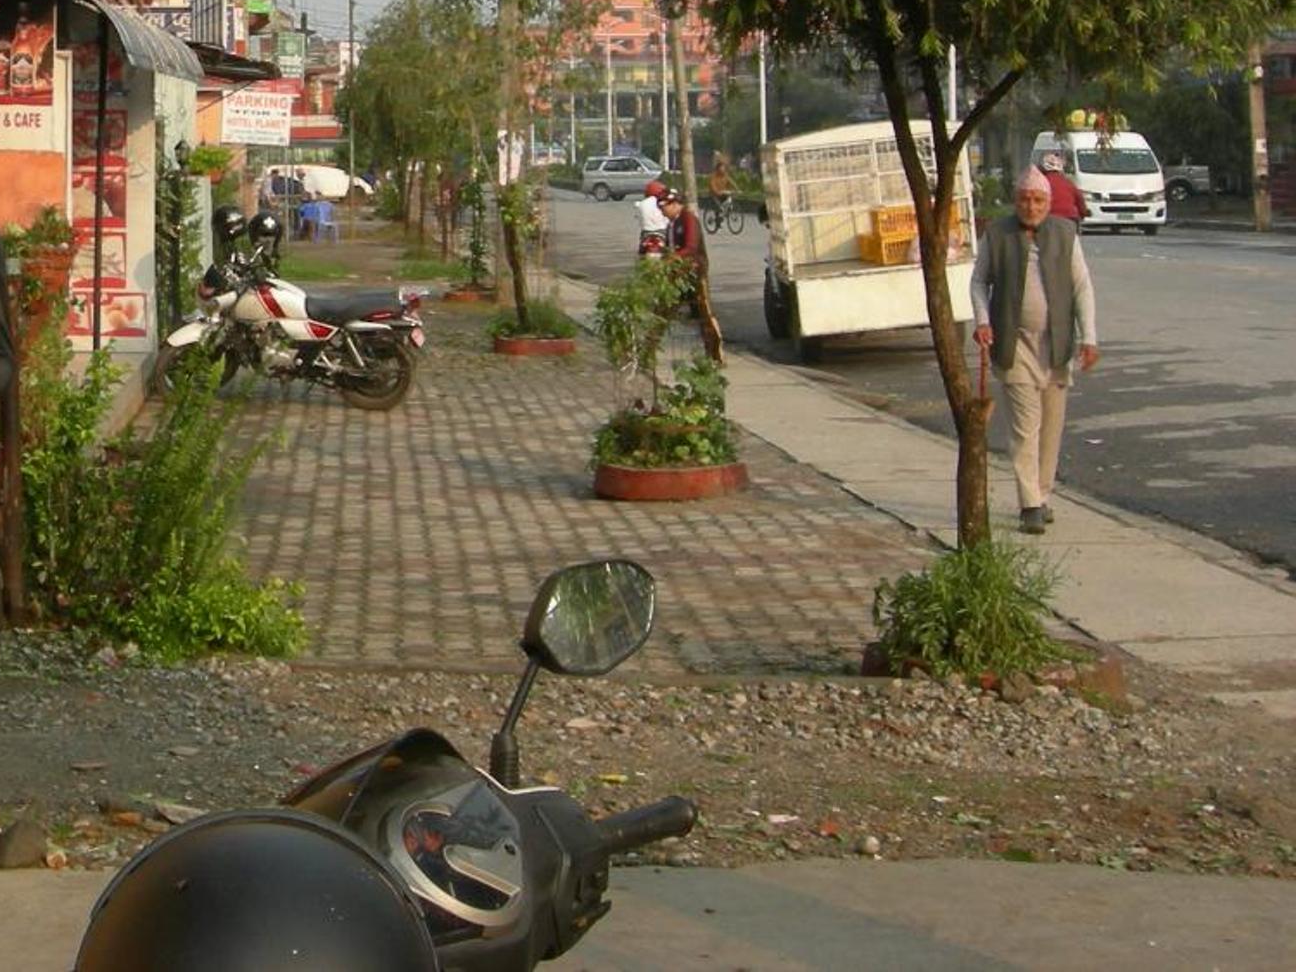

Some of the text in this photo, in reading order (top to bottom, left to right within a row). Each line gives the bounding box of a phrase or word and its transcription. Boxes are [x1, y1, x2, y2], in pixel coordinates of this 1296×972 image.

[226, 94, 288, 109] PARKING
[3, 112, 11, 127] &
[14, 112, 41, 128] CAFE
